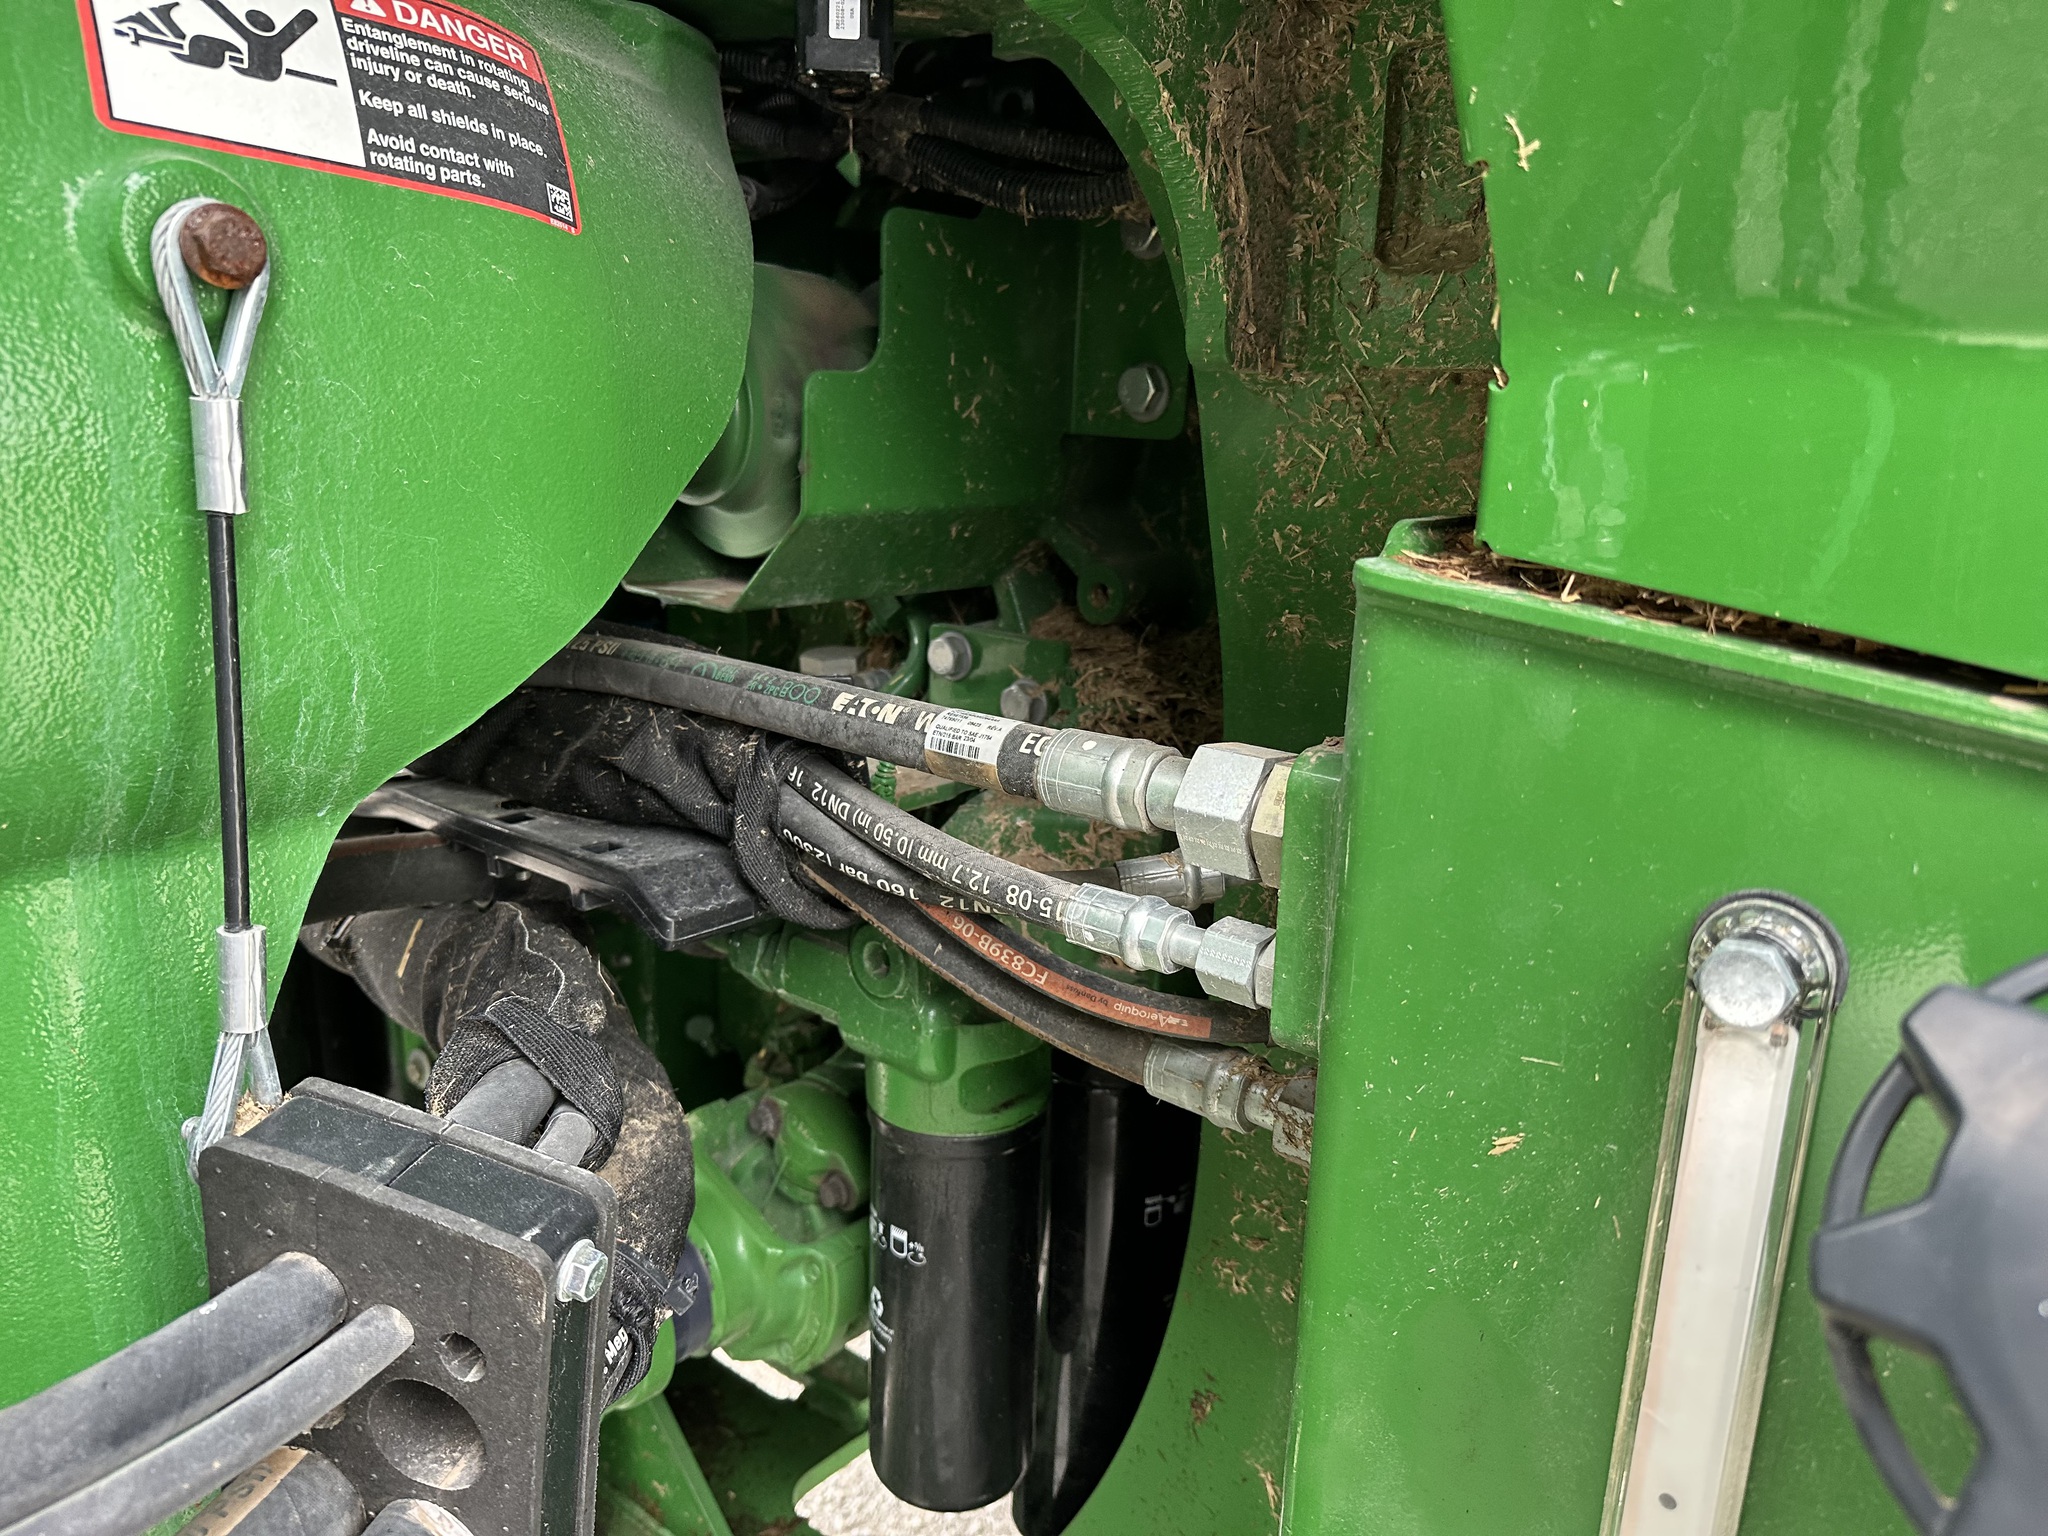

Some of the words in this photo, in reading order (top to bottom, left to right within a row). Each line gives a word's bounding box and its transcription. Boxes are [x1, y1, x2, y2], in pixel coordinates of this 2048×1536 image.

[392, 0, 528, 70] DANGER
[341, 17, 458, 61] Entanglement
[460, 50, 475, 67] in
[477, 59, 530, 93] rotating
[347, 37, 421, 67] driveline
[424, 57, 454, 76] can
[457, 67, 501, 92] cause
[503, 84, 550, 116] serious
[350, 53, 400, 82] injury
[405, 68, 423, 84] or
[427, 73, 477, 99] death.
[358, 89, 404, 116] Keep
[407, 103, 428, 120] all
[431, 108, 489, 136] shields
[491, 124, 506, 141] in
[508, 132, 548, 158] place.
[367, 128, 416, 153] Avoid
[419, 142, 480, 168] contact
[483, 157, 515, 178] with
[370, 151, 436, 180] rotating
[440, 167, 486, 188] parts.
[935, 724, 960, 734] QUALIFIED
[810, 781, 851, 821] DN12
[853, 808, 873, 837] in)
[839, 862, 869, 884] bar
[918, 845, 949, 870] mm
[876, 878, 920, 901] 160
[951, 867, 991, 895] 12.7
[951, 914, 1049, 986] FC839B-06
[1099, 997, 1109, 1007] by
[1113, 1001, 1170, 1028] Aeroquip
